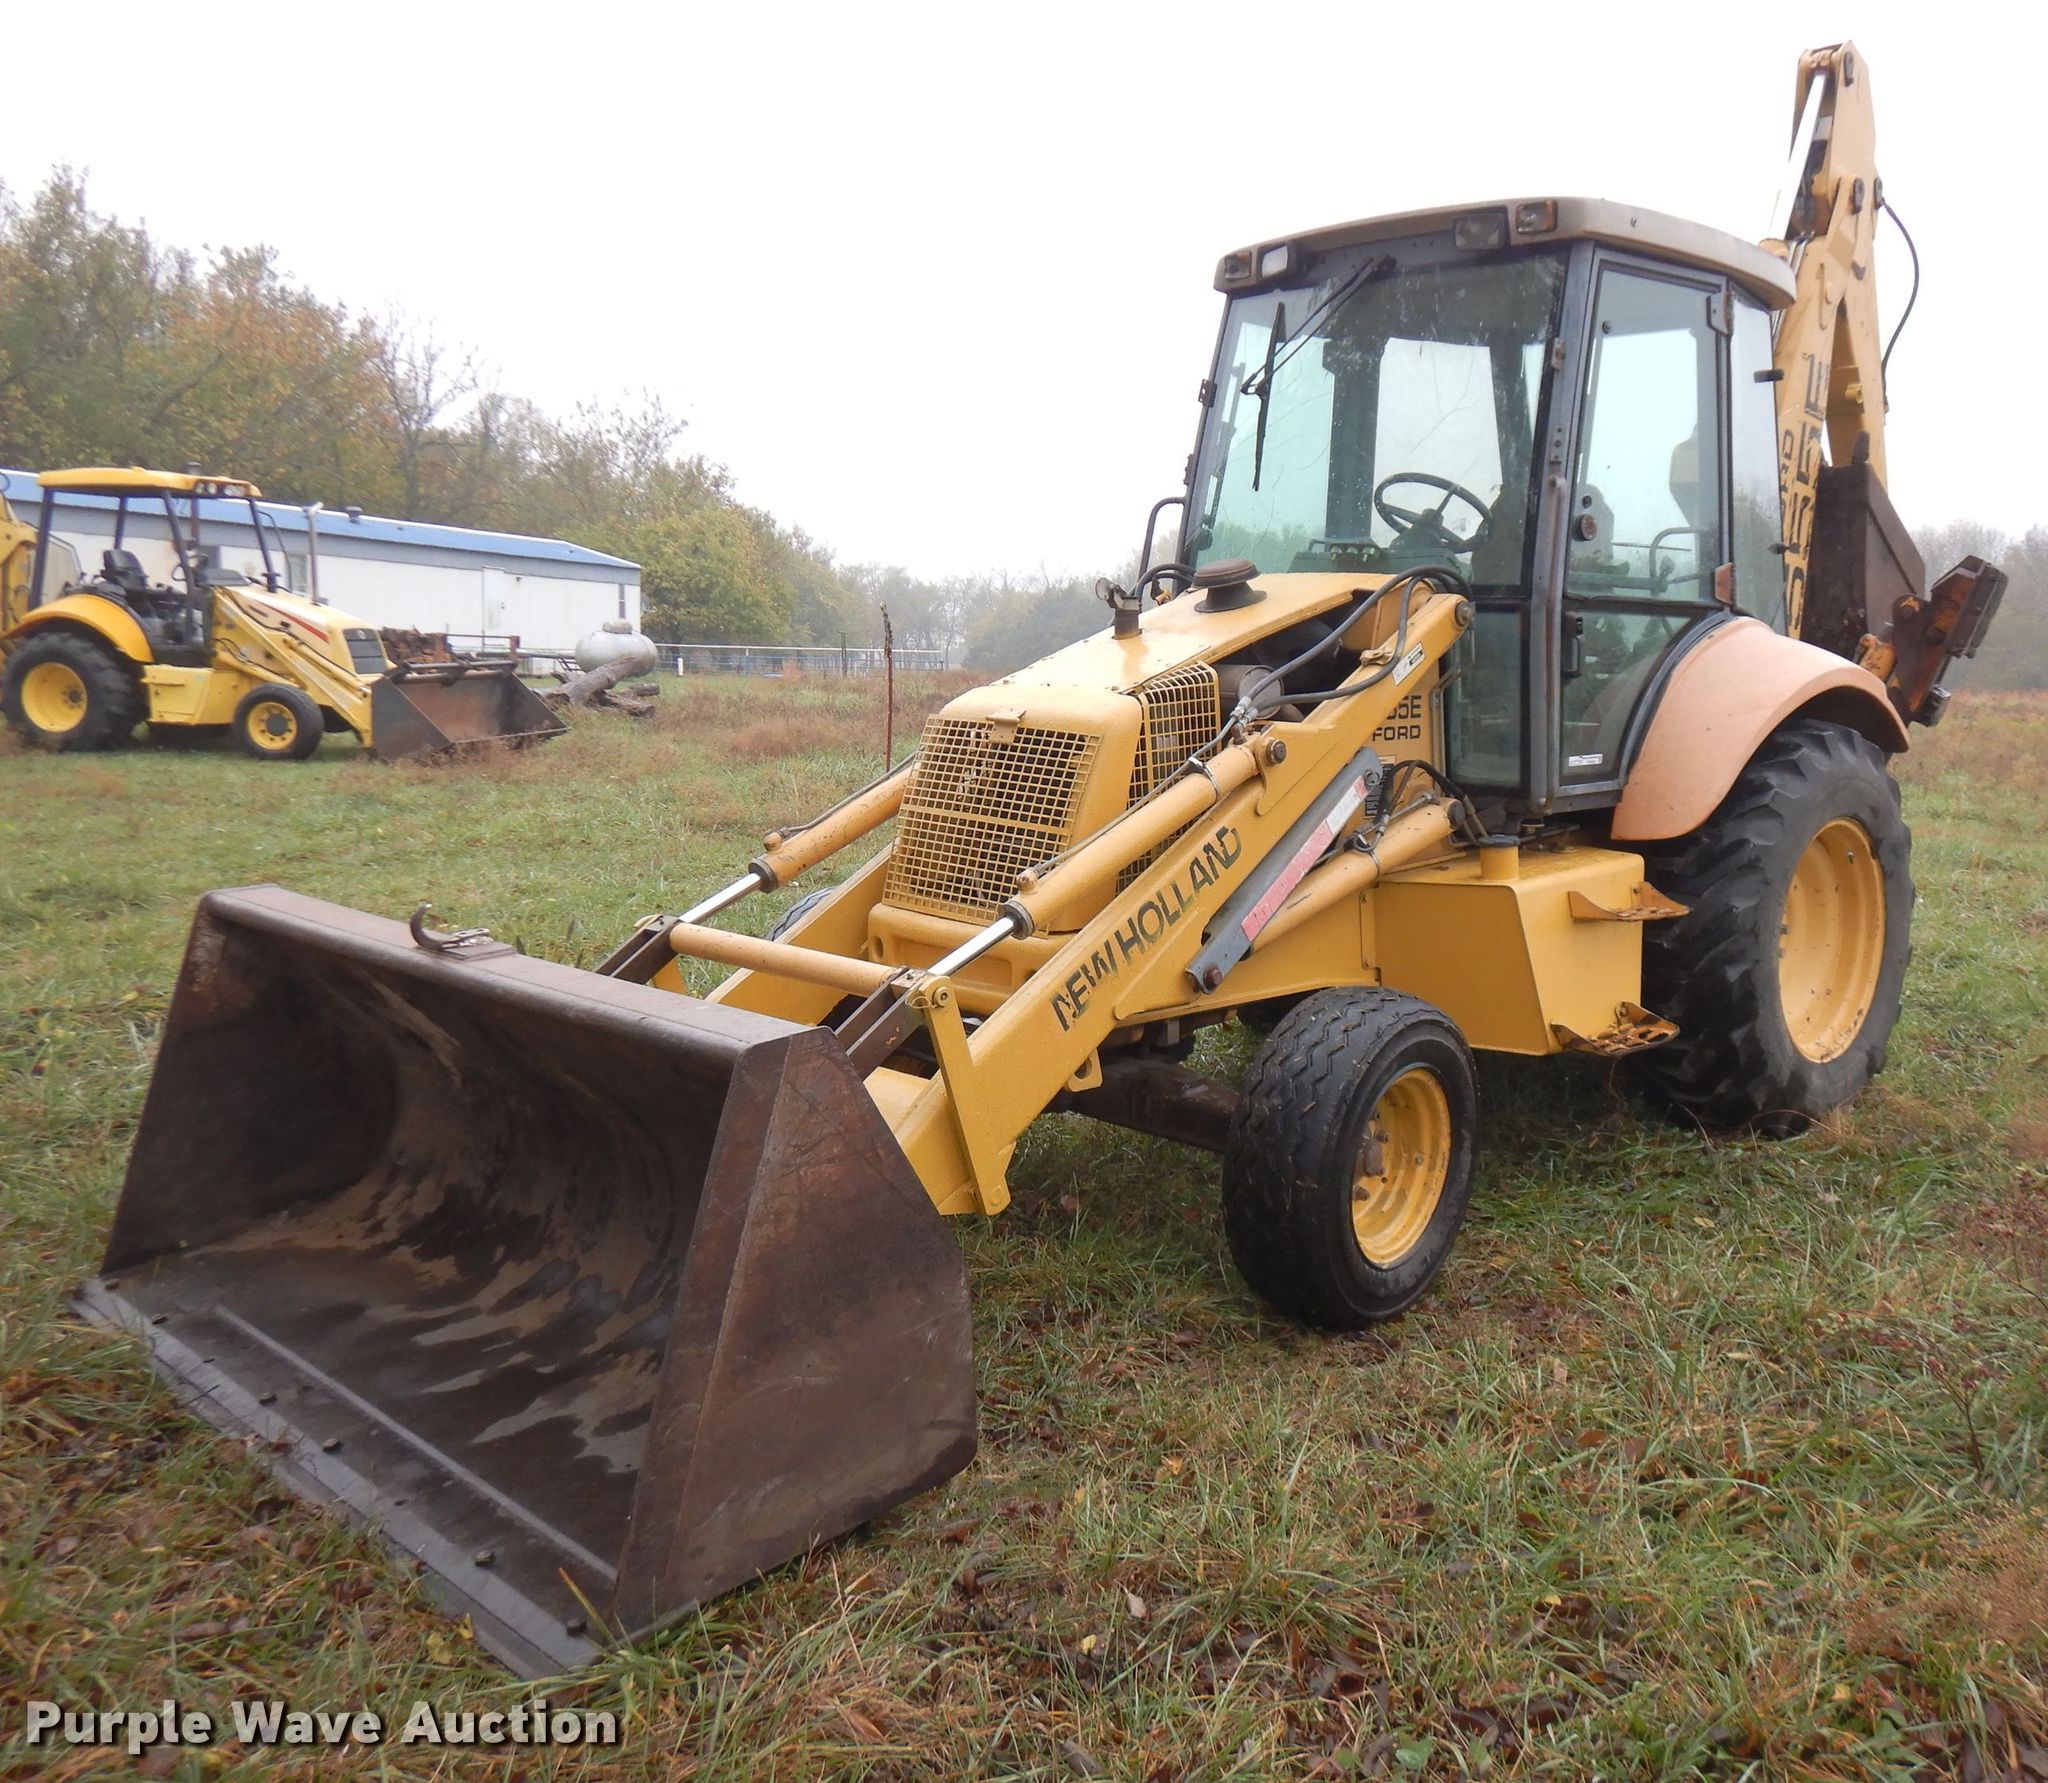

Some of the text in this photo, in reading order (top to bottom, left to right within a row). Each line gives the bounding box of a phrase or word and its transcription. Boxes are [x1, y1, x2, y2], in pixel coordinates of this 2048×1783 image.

[1372, 725, 1421, 742] FORD
[1050, 825, 1242, 1032] NEW HOLLAND
